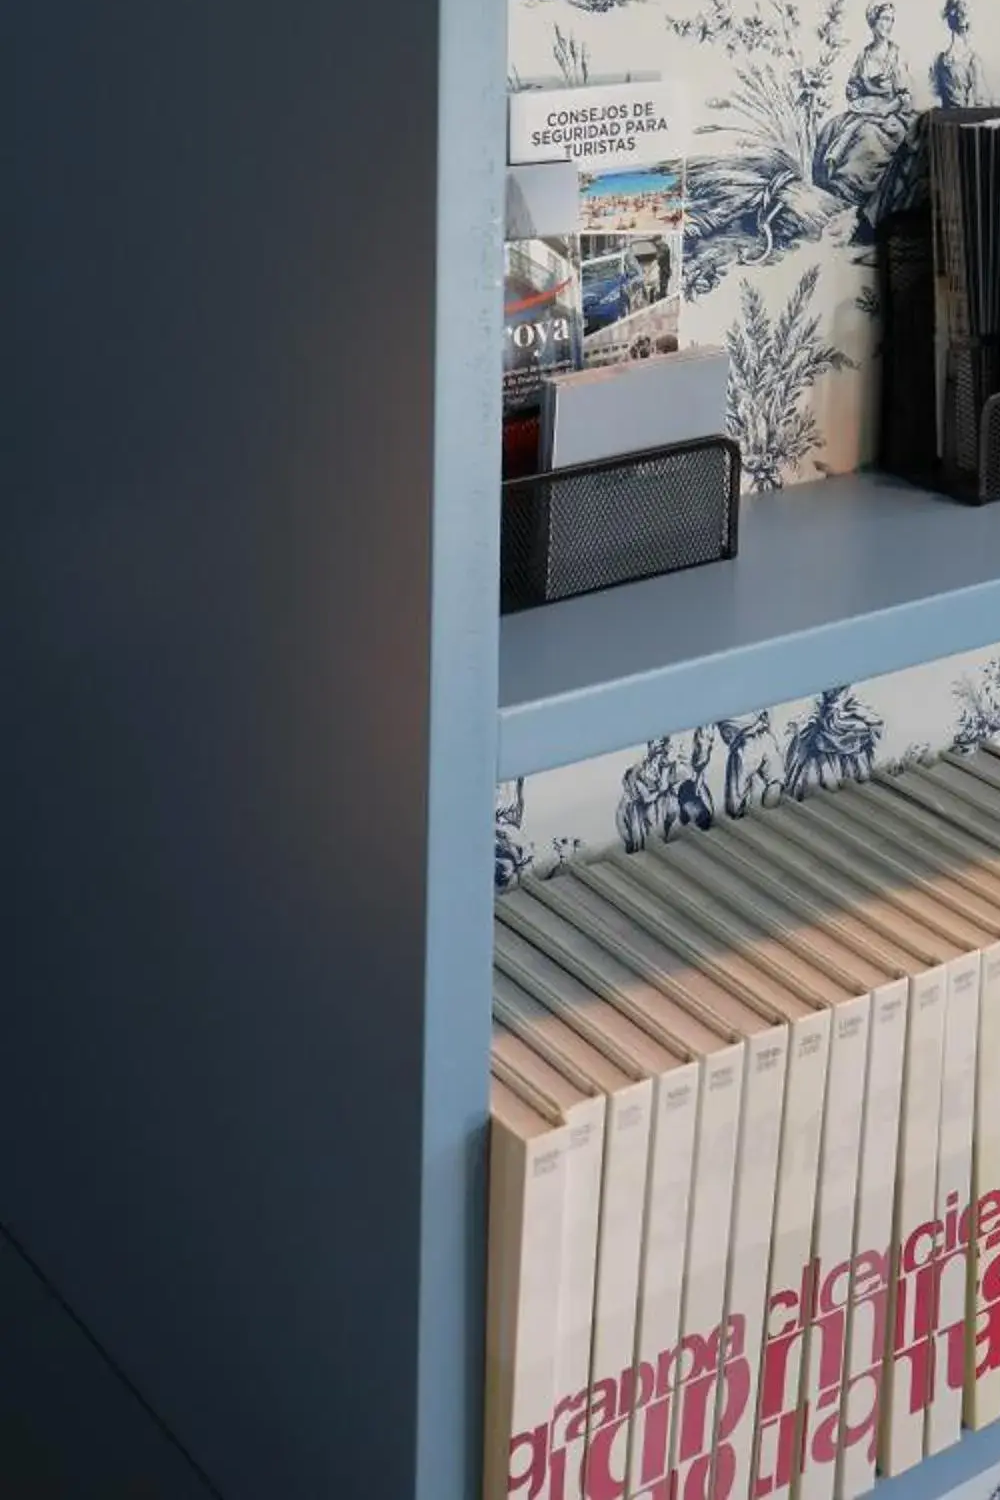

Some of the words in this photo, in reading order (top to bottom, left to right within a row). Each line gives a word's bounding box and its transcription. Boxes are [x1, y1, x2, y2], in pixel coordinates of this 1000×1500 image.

[546, 103, 629, 128] CONSEJOS
[633, 101, 656, 117] DE
[531, 121, 622, 147] SEGURIDAD
[625, 117, 669, 135] PARA
[564, 136, 637, 159] TURISTAS
